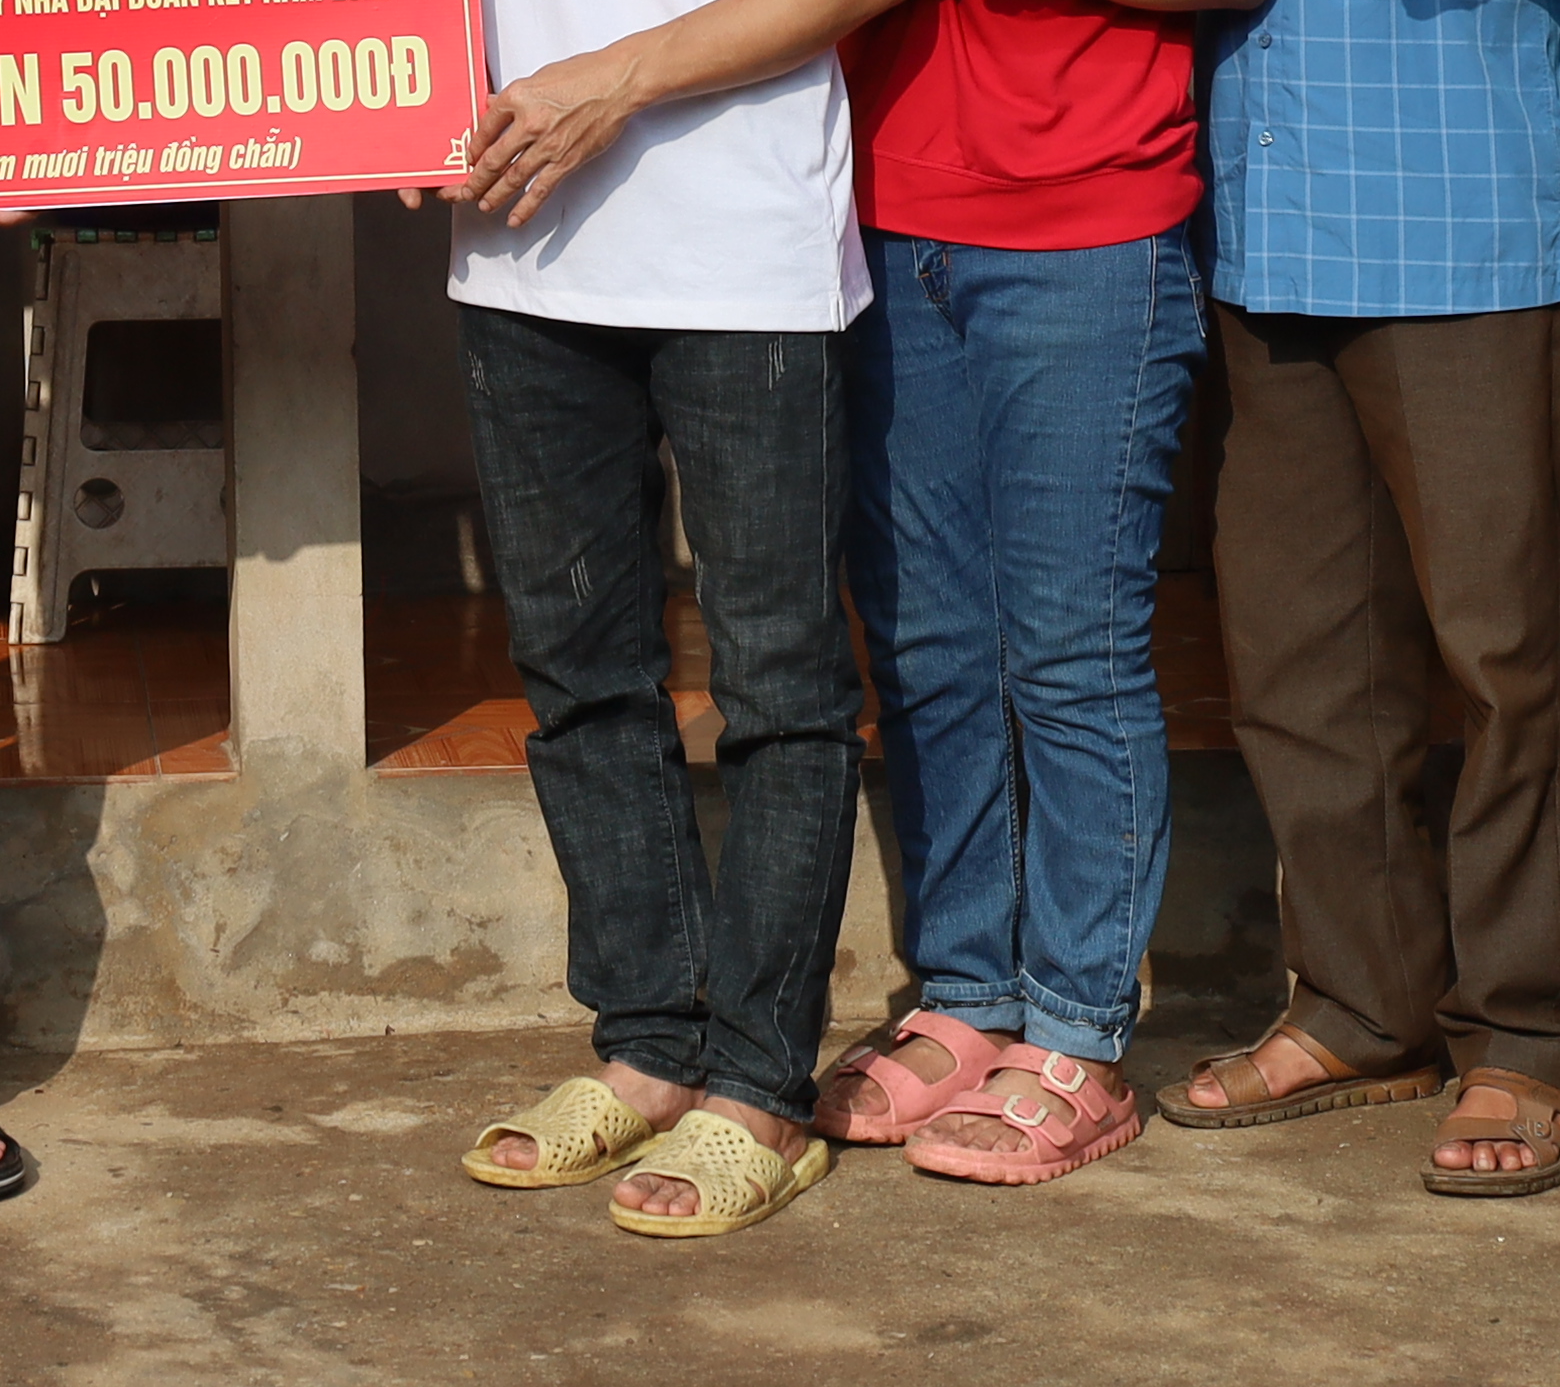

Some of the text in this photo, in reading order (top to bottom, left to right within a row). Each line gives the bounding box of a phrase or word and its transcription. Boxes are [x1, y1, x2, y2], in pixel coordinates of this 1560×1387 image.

[60, 35, 432, 124] 50.000.000Đ
[21, 145, 90, 180] mươi
[93, 142, 155, 182] triệu
[159, 135, 224, 175] đồng
[228, 127, 302, 171] chẵn)
